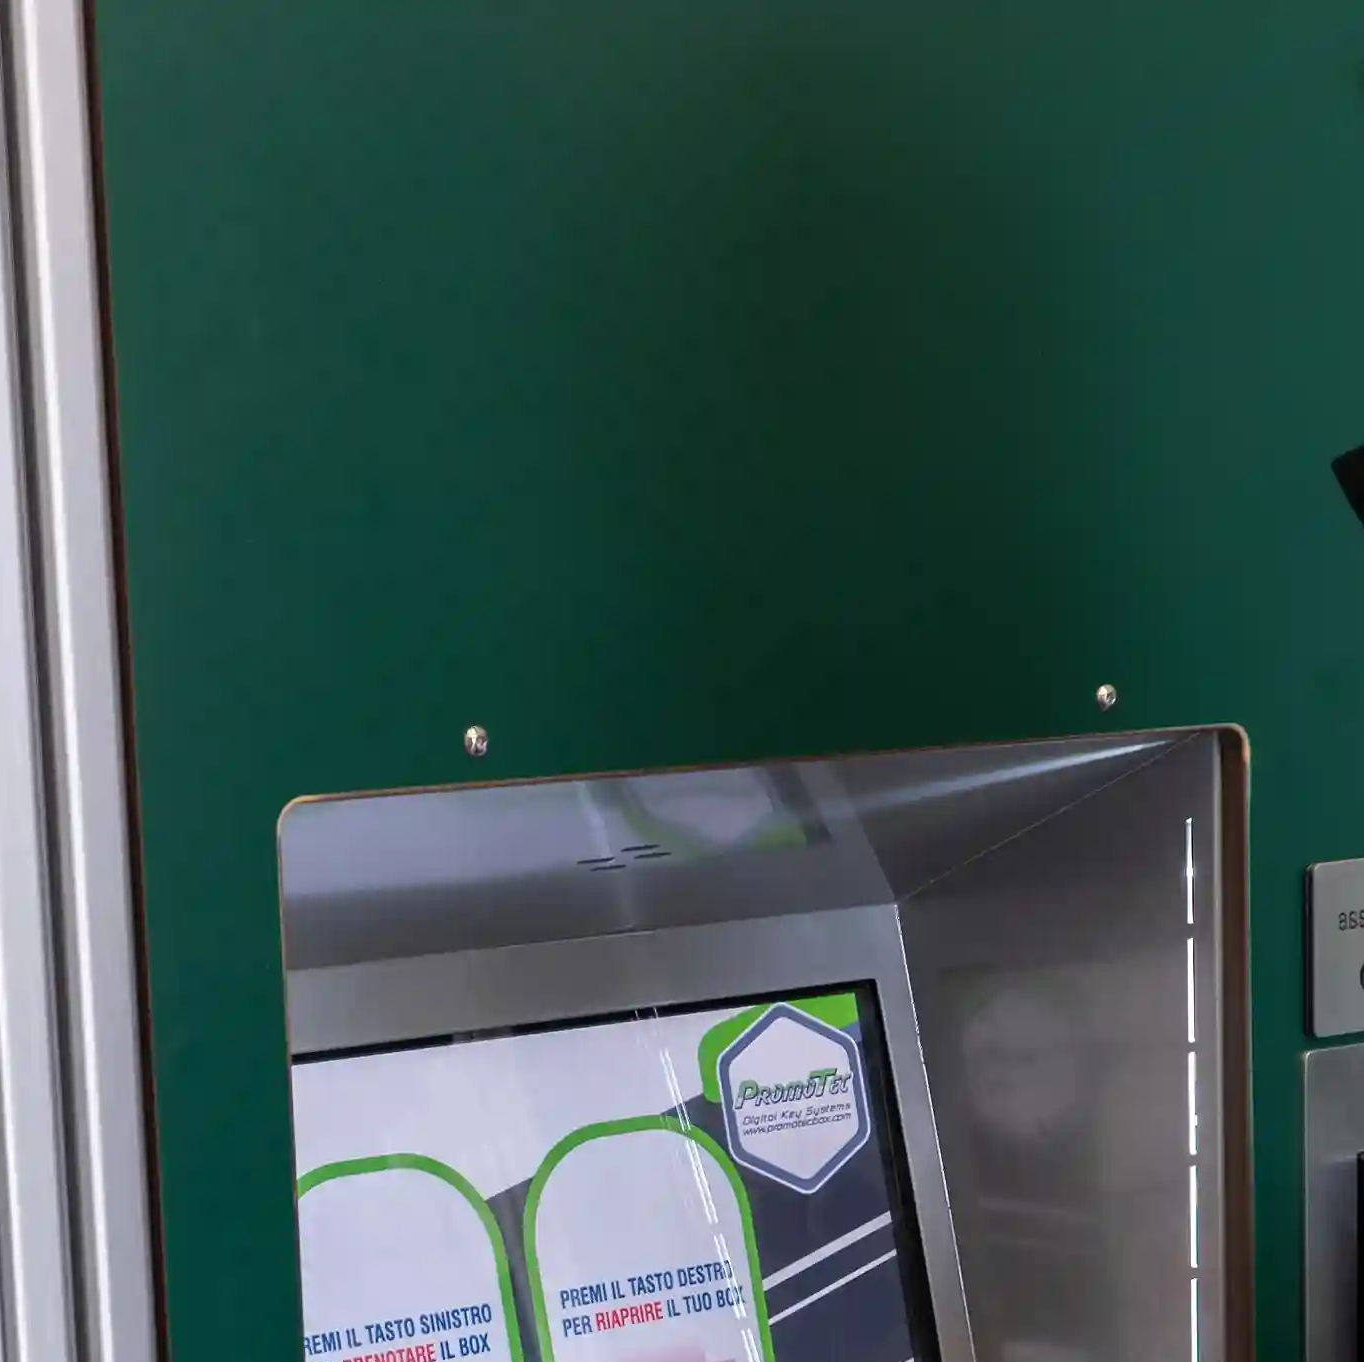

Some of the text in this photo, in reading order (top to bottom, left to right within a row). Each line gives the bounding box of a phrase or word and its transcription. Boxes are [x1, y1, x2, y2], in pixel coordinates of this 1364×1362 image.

[742, 1102, 852, 1126] Digital Key Systems
[560, 1259, 733, 1309] PREMI IL TASTO DESTRO
[304, 1303, 493, 1356] REMI IL TASTO SINISTRO
[562, 1285, 746, 1337] PER RIAPRIRE IL TUO BOX
[440, 1341, 456, 1361] IL
[459, 1332, 492, 1358] BOX
